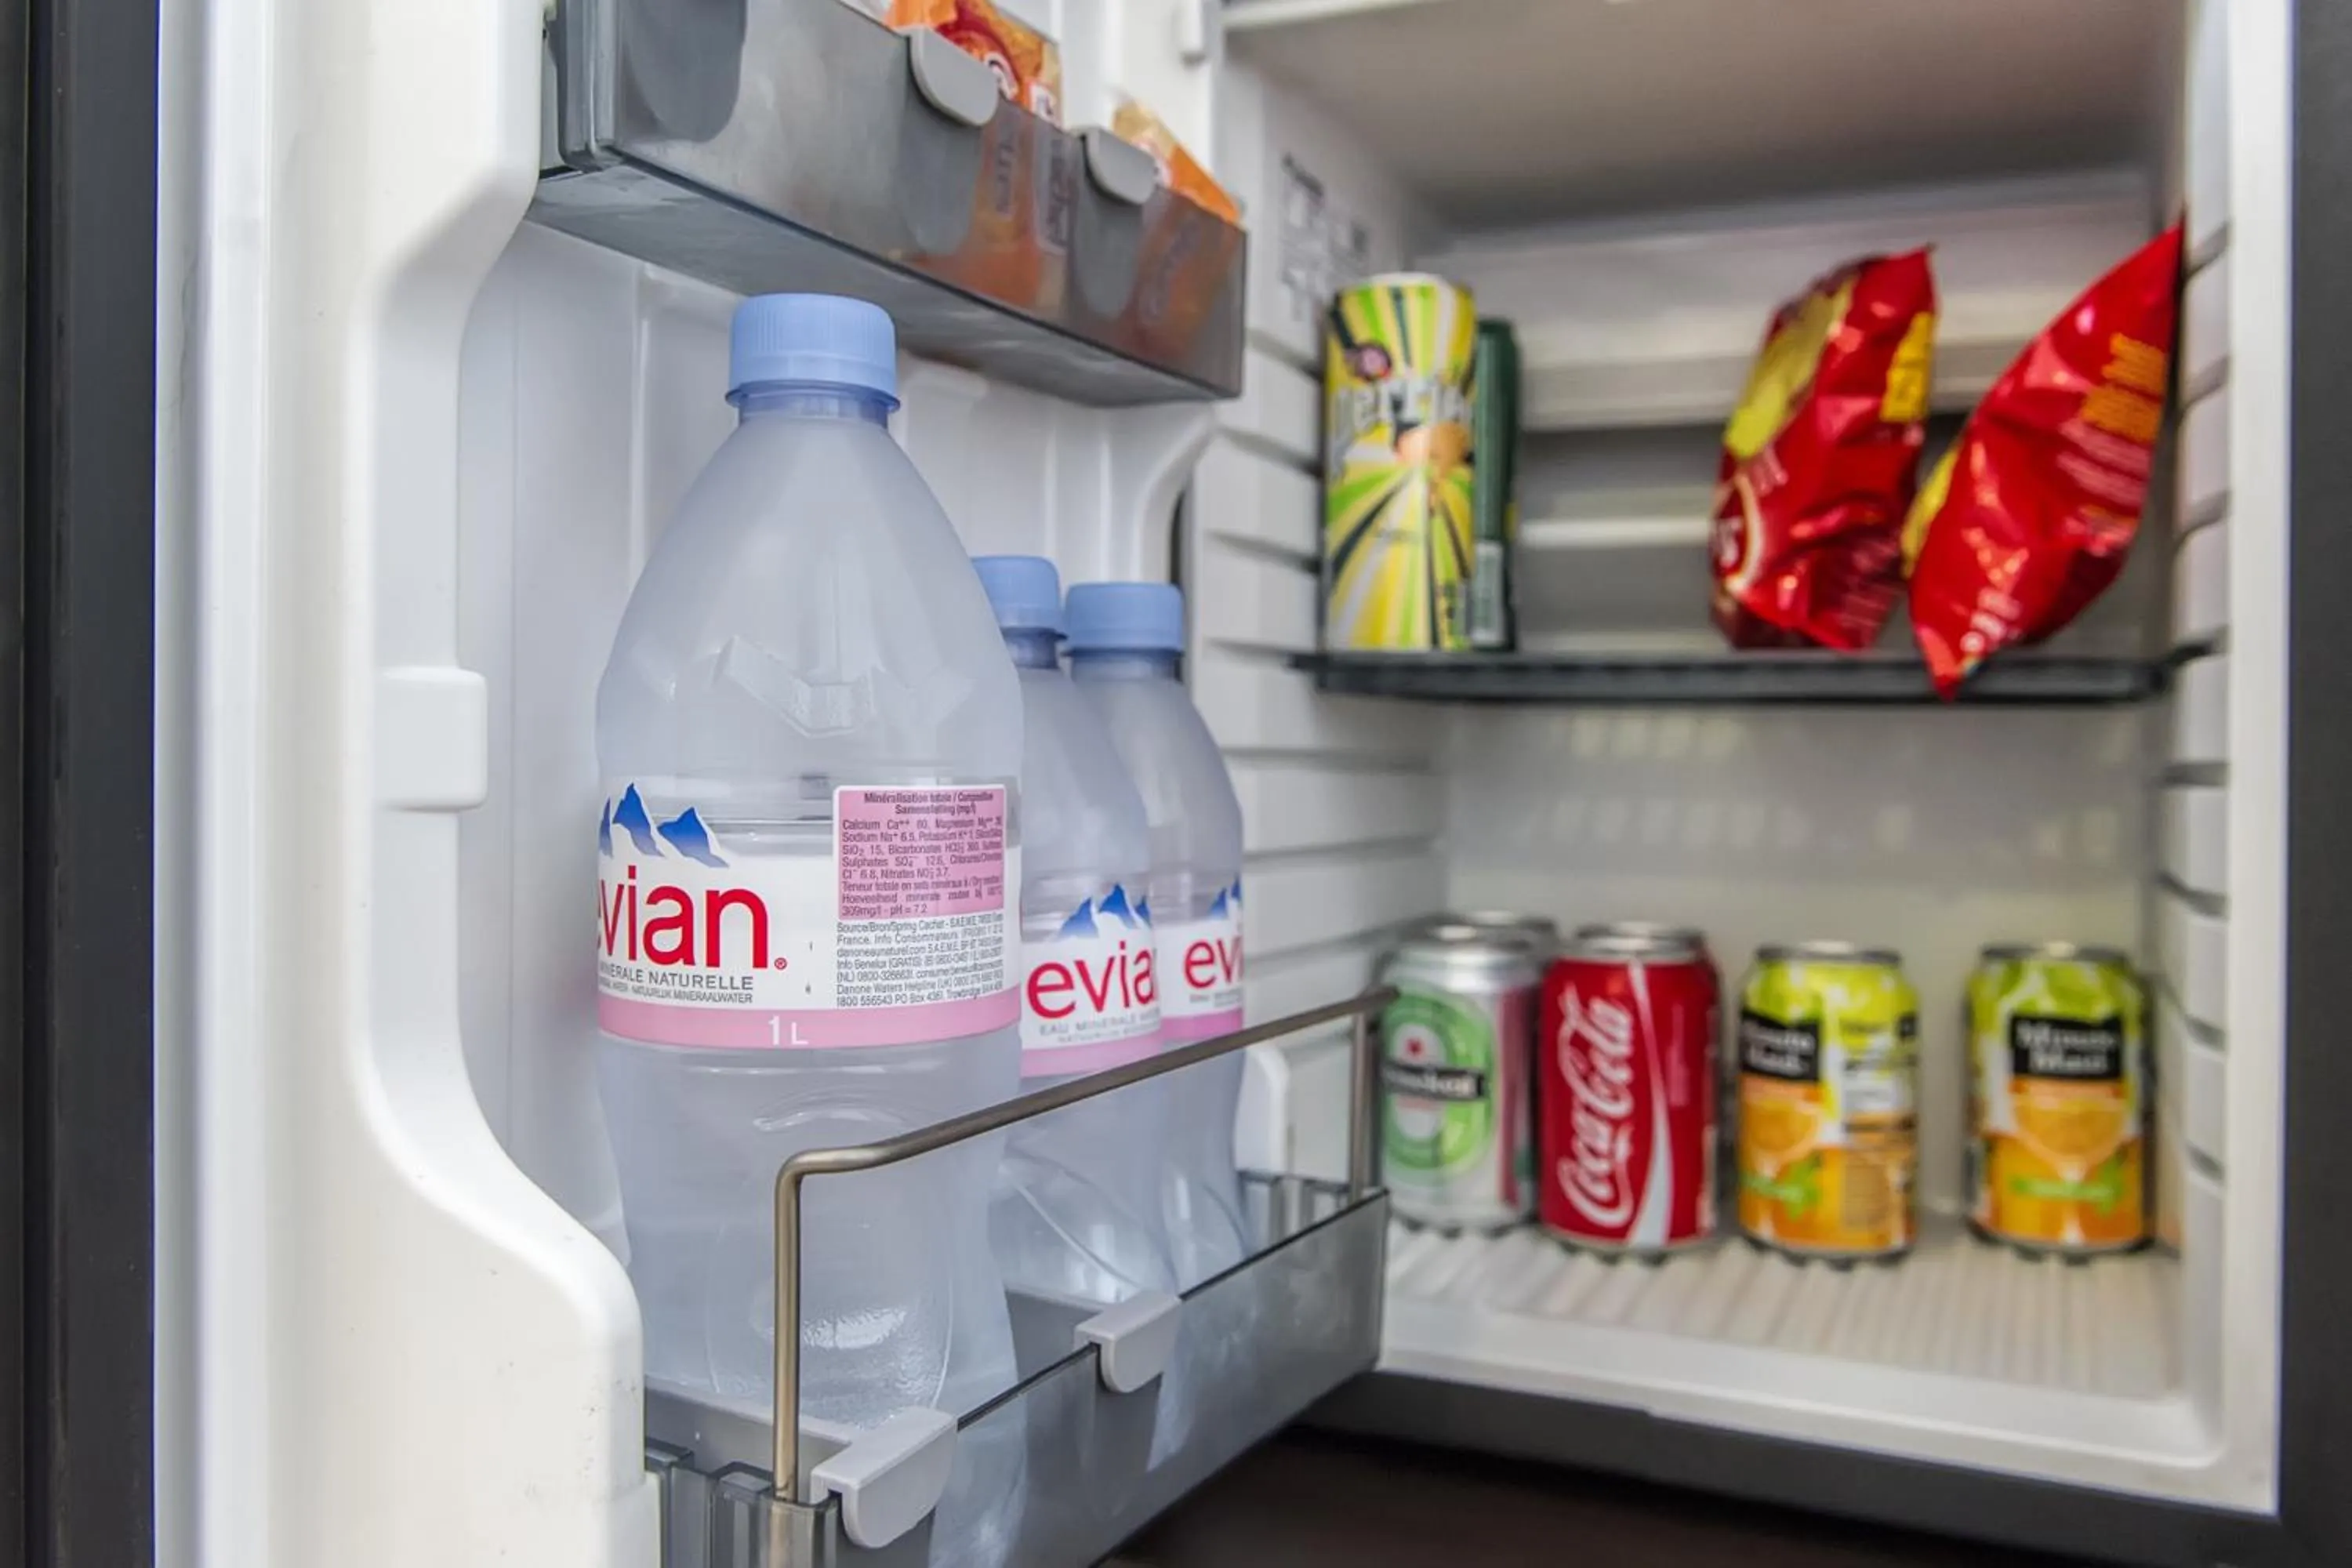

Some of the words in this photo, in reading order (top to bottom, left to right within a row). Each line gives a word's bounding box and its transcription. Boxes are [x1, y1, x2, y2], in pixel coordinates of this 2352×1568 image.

[843, 819, 880, 829] Calcium
[842, 832, 878, 842] Sodium
[597, 865, 768, 969] vian
[649, 971, 753, 990] NATURELLE
[837, 984, 872, 994] Danone
